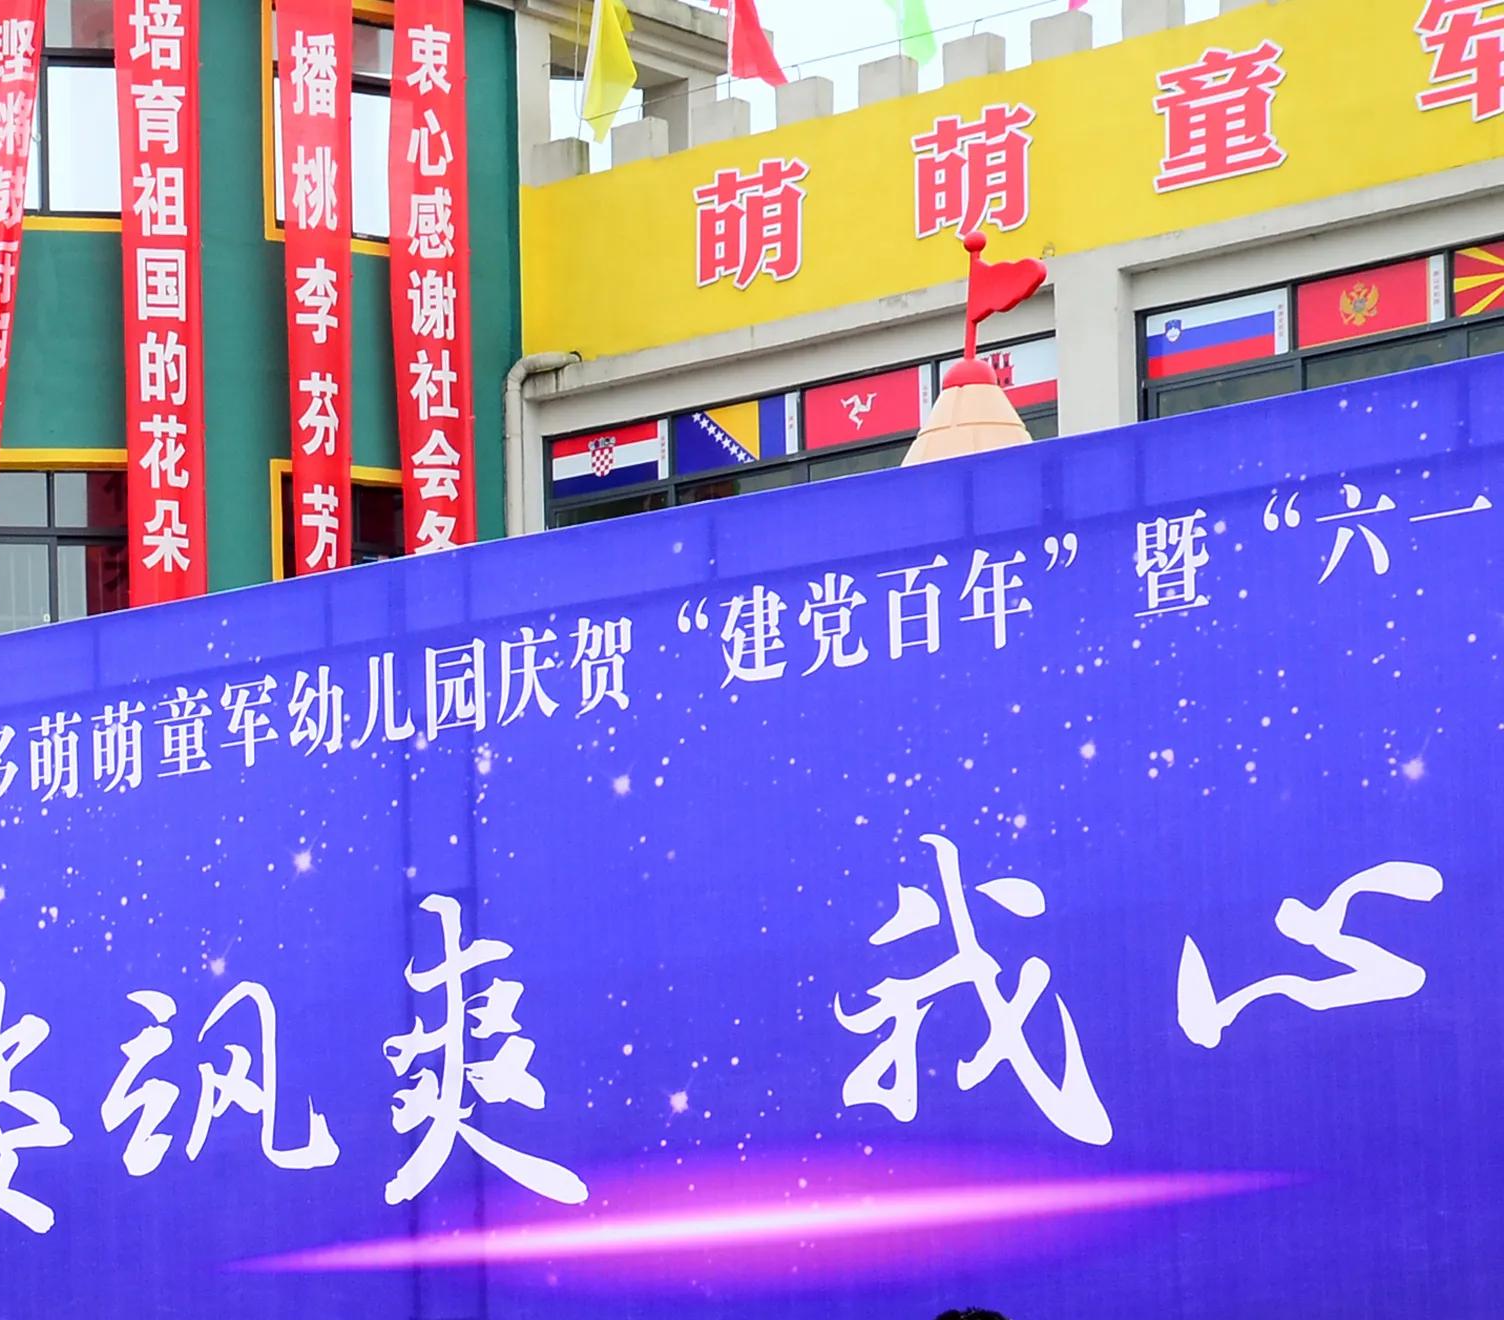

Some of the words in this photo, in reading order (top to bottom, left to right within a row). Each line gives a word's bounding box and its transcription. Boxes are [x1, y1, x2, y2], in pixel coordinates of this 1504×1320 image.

[128, 0, 190, 573] 培育祖国的花朵
[290, 30, 339, 571] 播桃李芬芳
[834, 834, 1444, 1146] 我心
